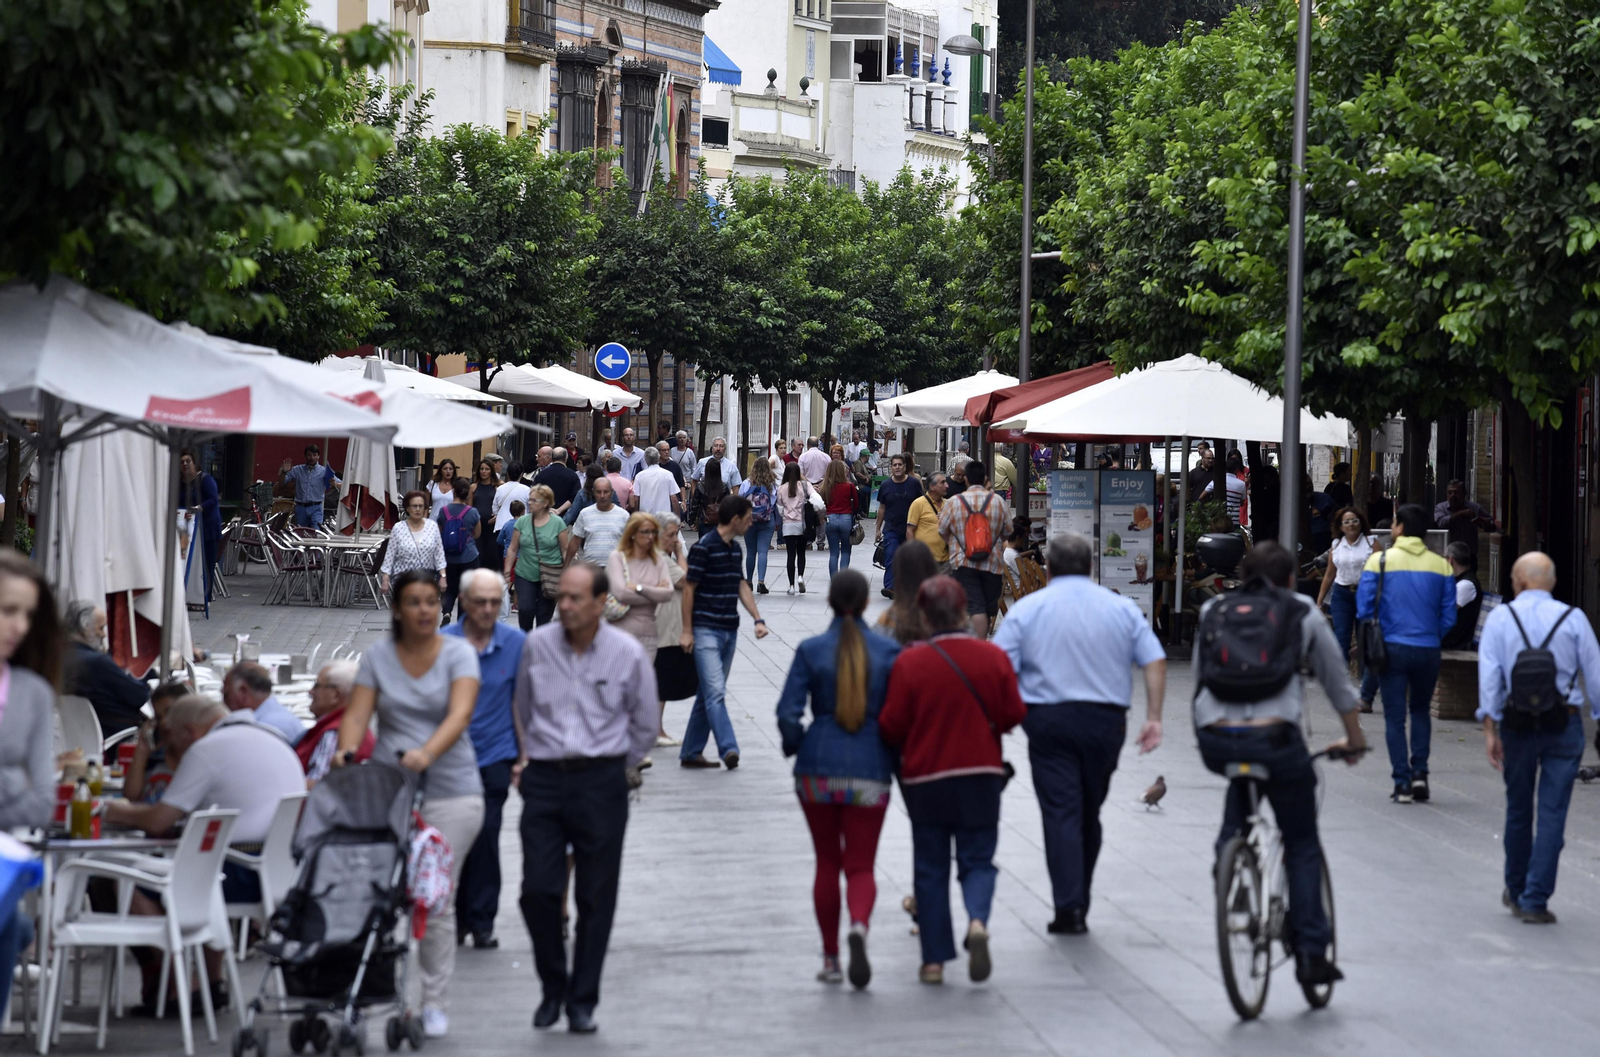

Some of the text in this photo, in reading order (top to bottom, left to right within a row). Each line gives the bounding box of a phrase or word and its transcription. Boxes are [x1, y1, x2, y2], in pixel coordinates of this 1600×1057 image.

[1059, 474, 1087, 482] Buenos
[1111, 477, 1144, 490] Enjoy
[1059, 489, 1087, 498] buenos
[1053, 498, 1093, 507] desayunos
